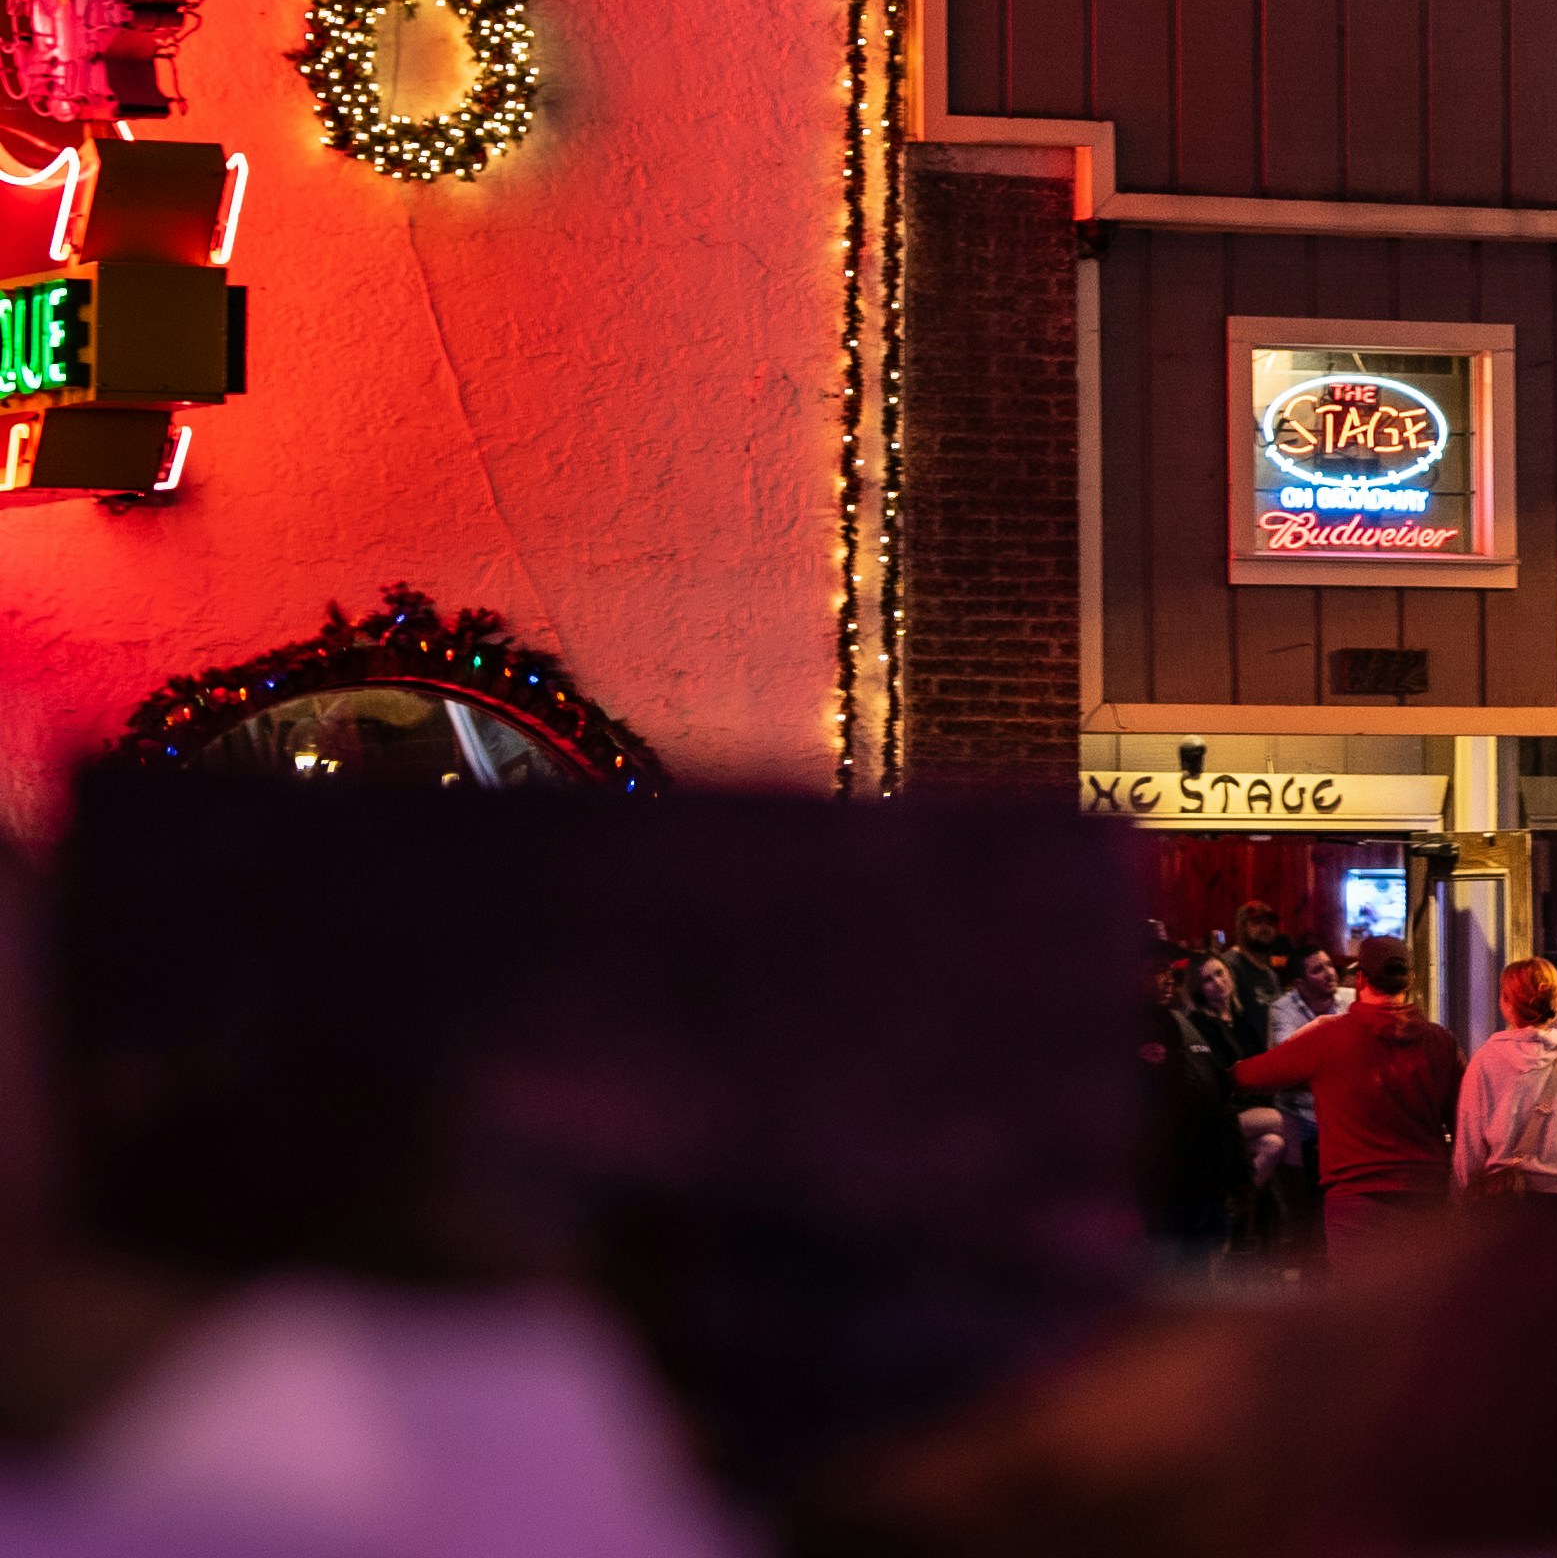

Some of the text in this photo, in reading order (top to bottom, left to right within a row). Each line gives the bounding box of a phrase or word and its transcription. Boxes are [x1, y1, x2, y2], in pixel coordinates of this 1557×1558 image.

[1329, 383, 1377, 403] THE
[1279, 395, 1436, 453] STAGE
[1281, 487, 1428, 512] ON BROADWAY
[1259, 511, 1458, 549] Budweiser
[1180, 774, 1342, 814] STAGE
